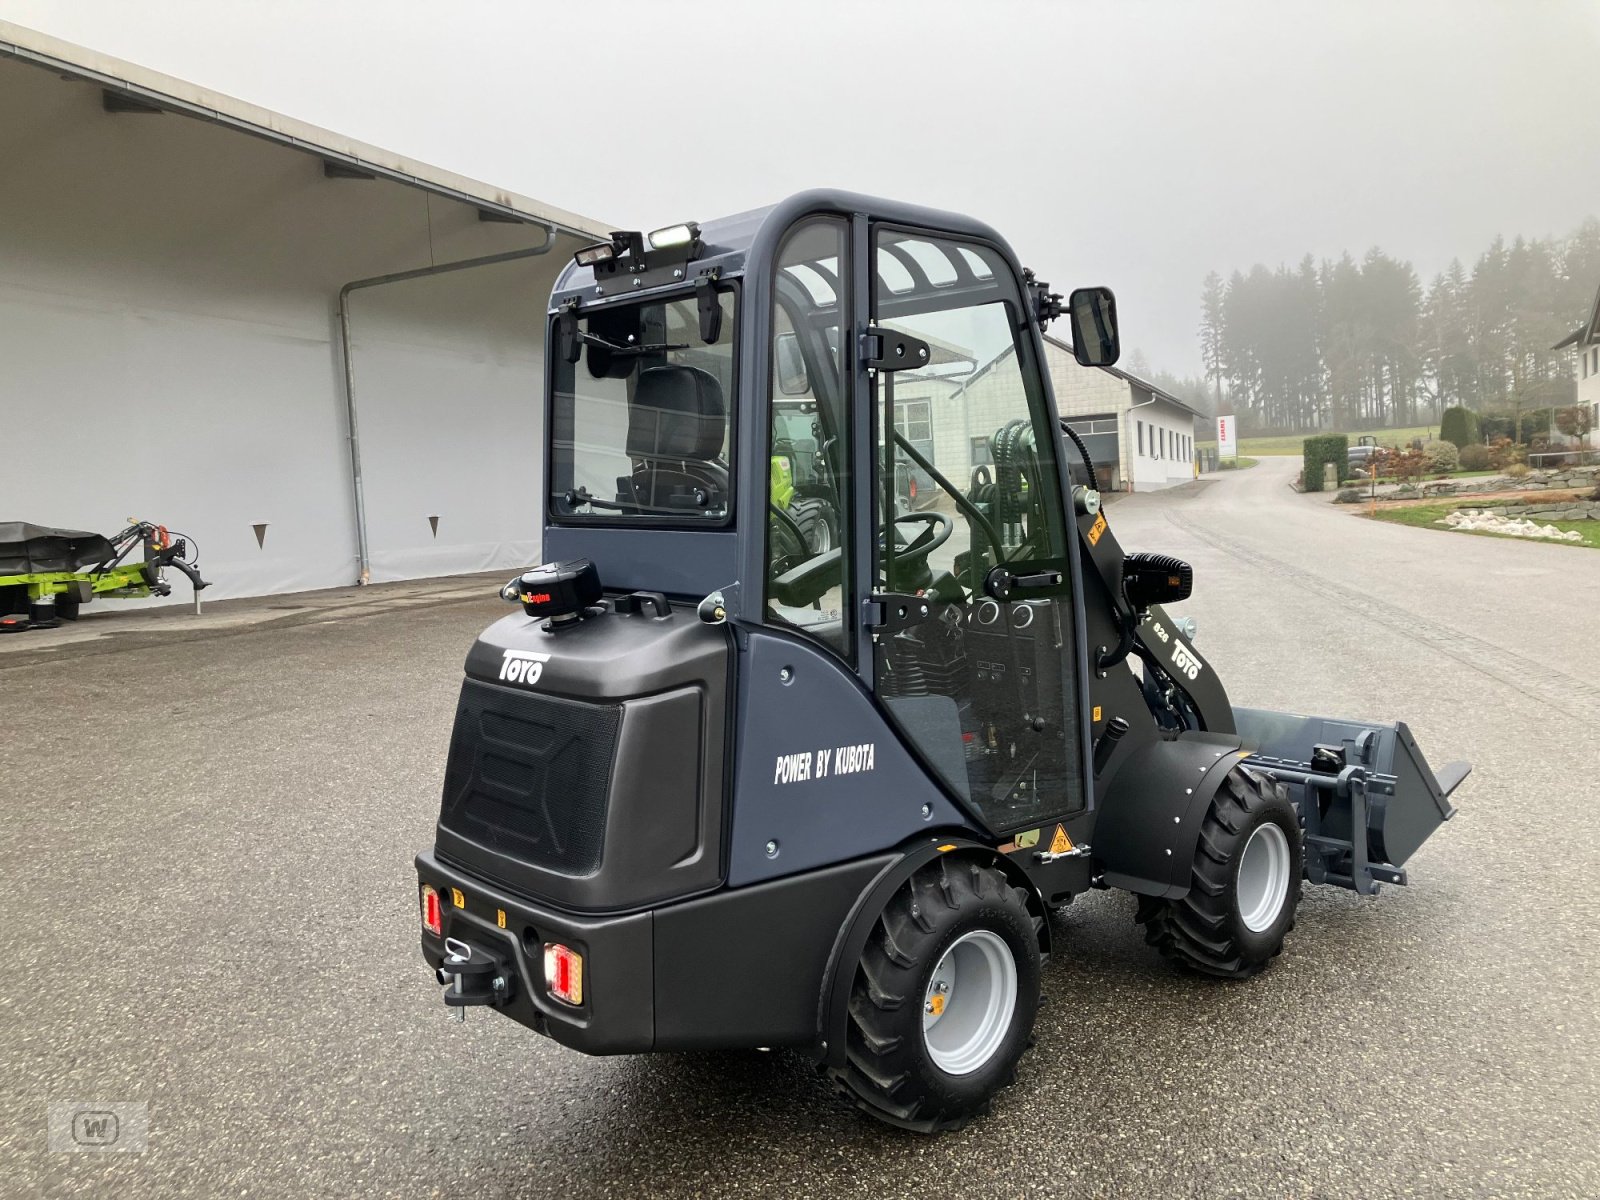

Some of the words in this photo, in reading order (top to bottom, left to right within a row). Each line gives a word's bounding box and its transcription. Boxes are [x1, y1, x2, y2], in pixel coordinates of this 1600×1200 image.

[499, 649, 552, 685] TOYO
[1171, 638, 1203, 680] TOYO
[774, 751, 812, 785] POWER
[815, 748, 832, 779] BY
[834, 743, 875, 776] KUBOTA
